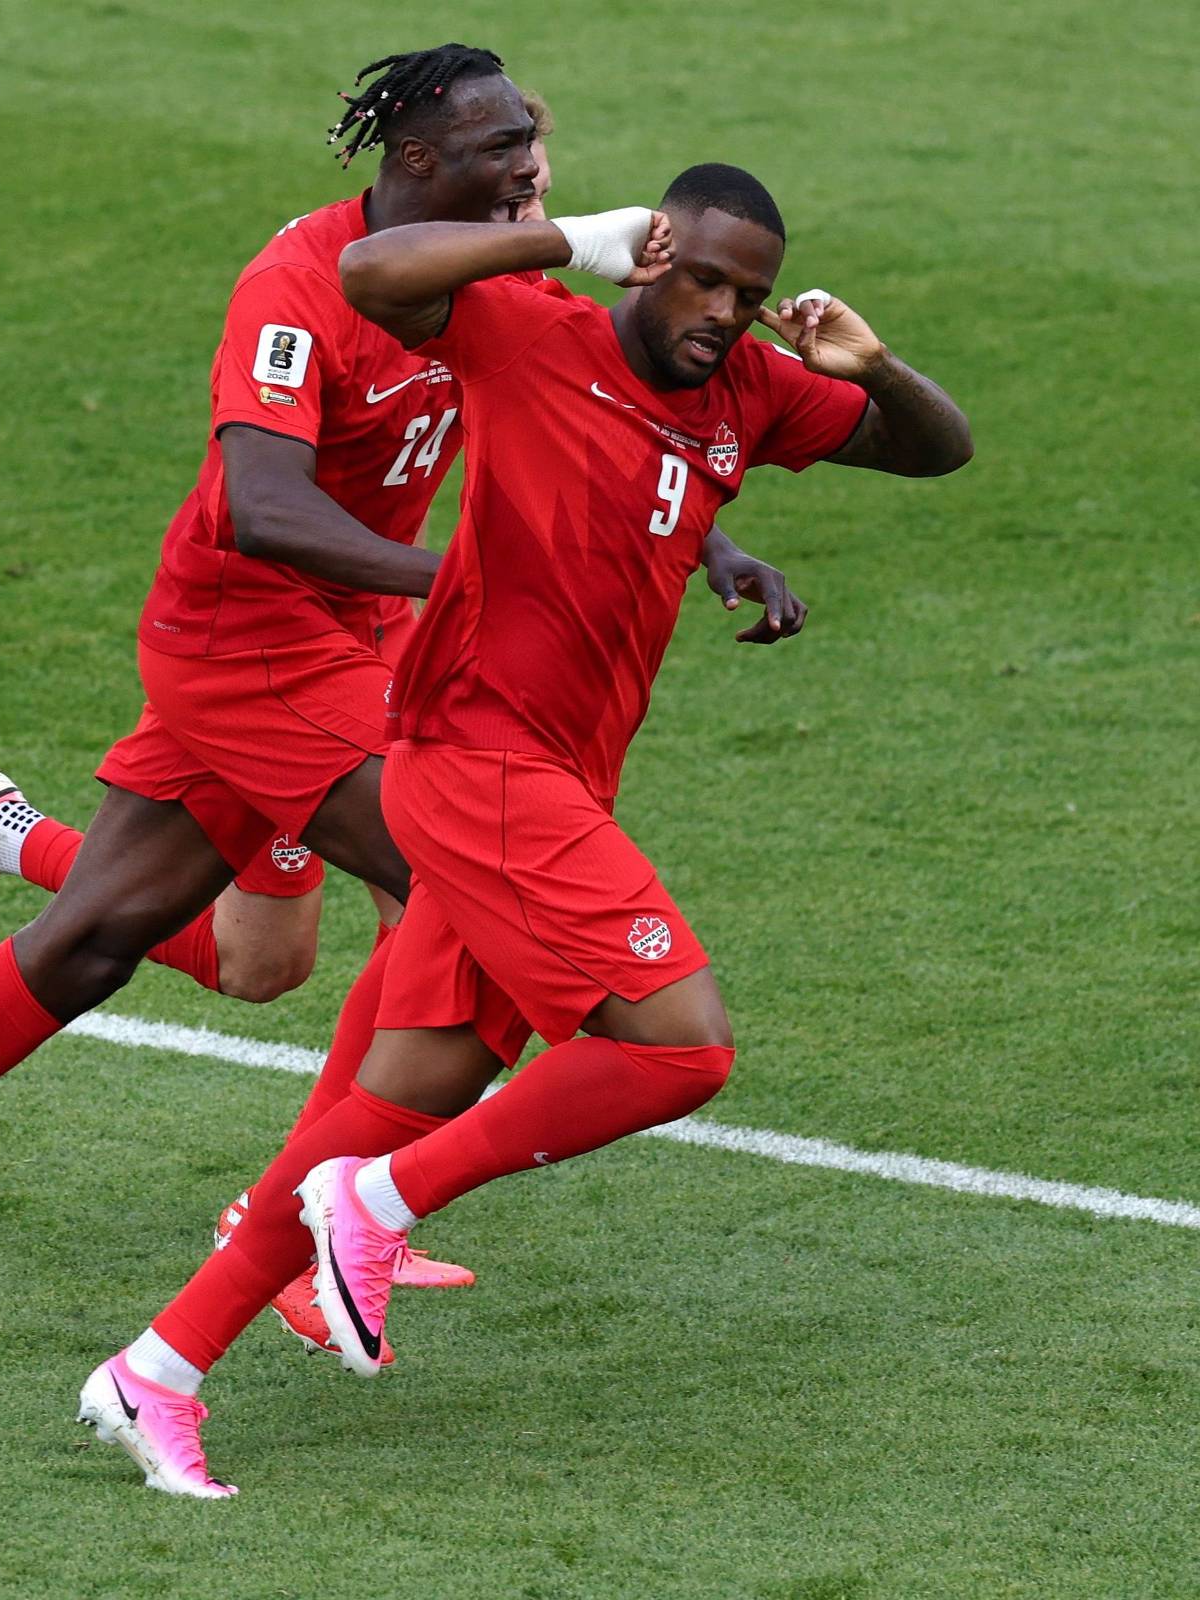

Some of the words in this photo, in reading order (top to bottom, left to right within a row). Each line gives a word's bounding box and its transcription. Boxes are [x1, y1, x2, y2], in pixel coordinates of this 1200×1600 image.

[382, 407, 458, 486] 24
[708, 445, 737, 455] CANADA
[648, 453, 689, 537] 9
[272, 847, 308, 857] CANAD
[633, 926, 667, 951] CANADA
